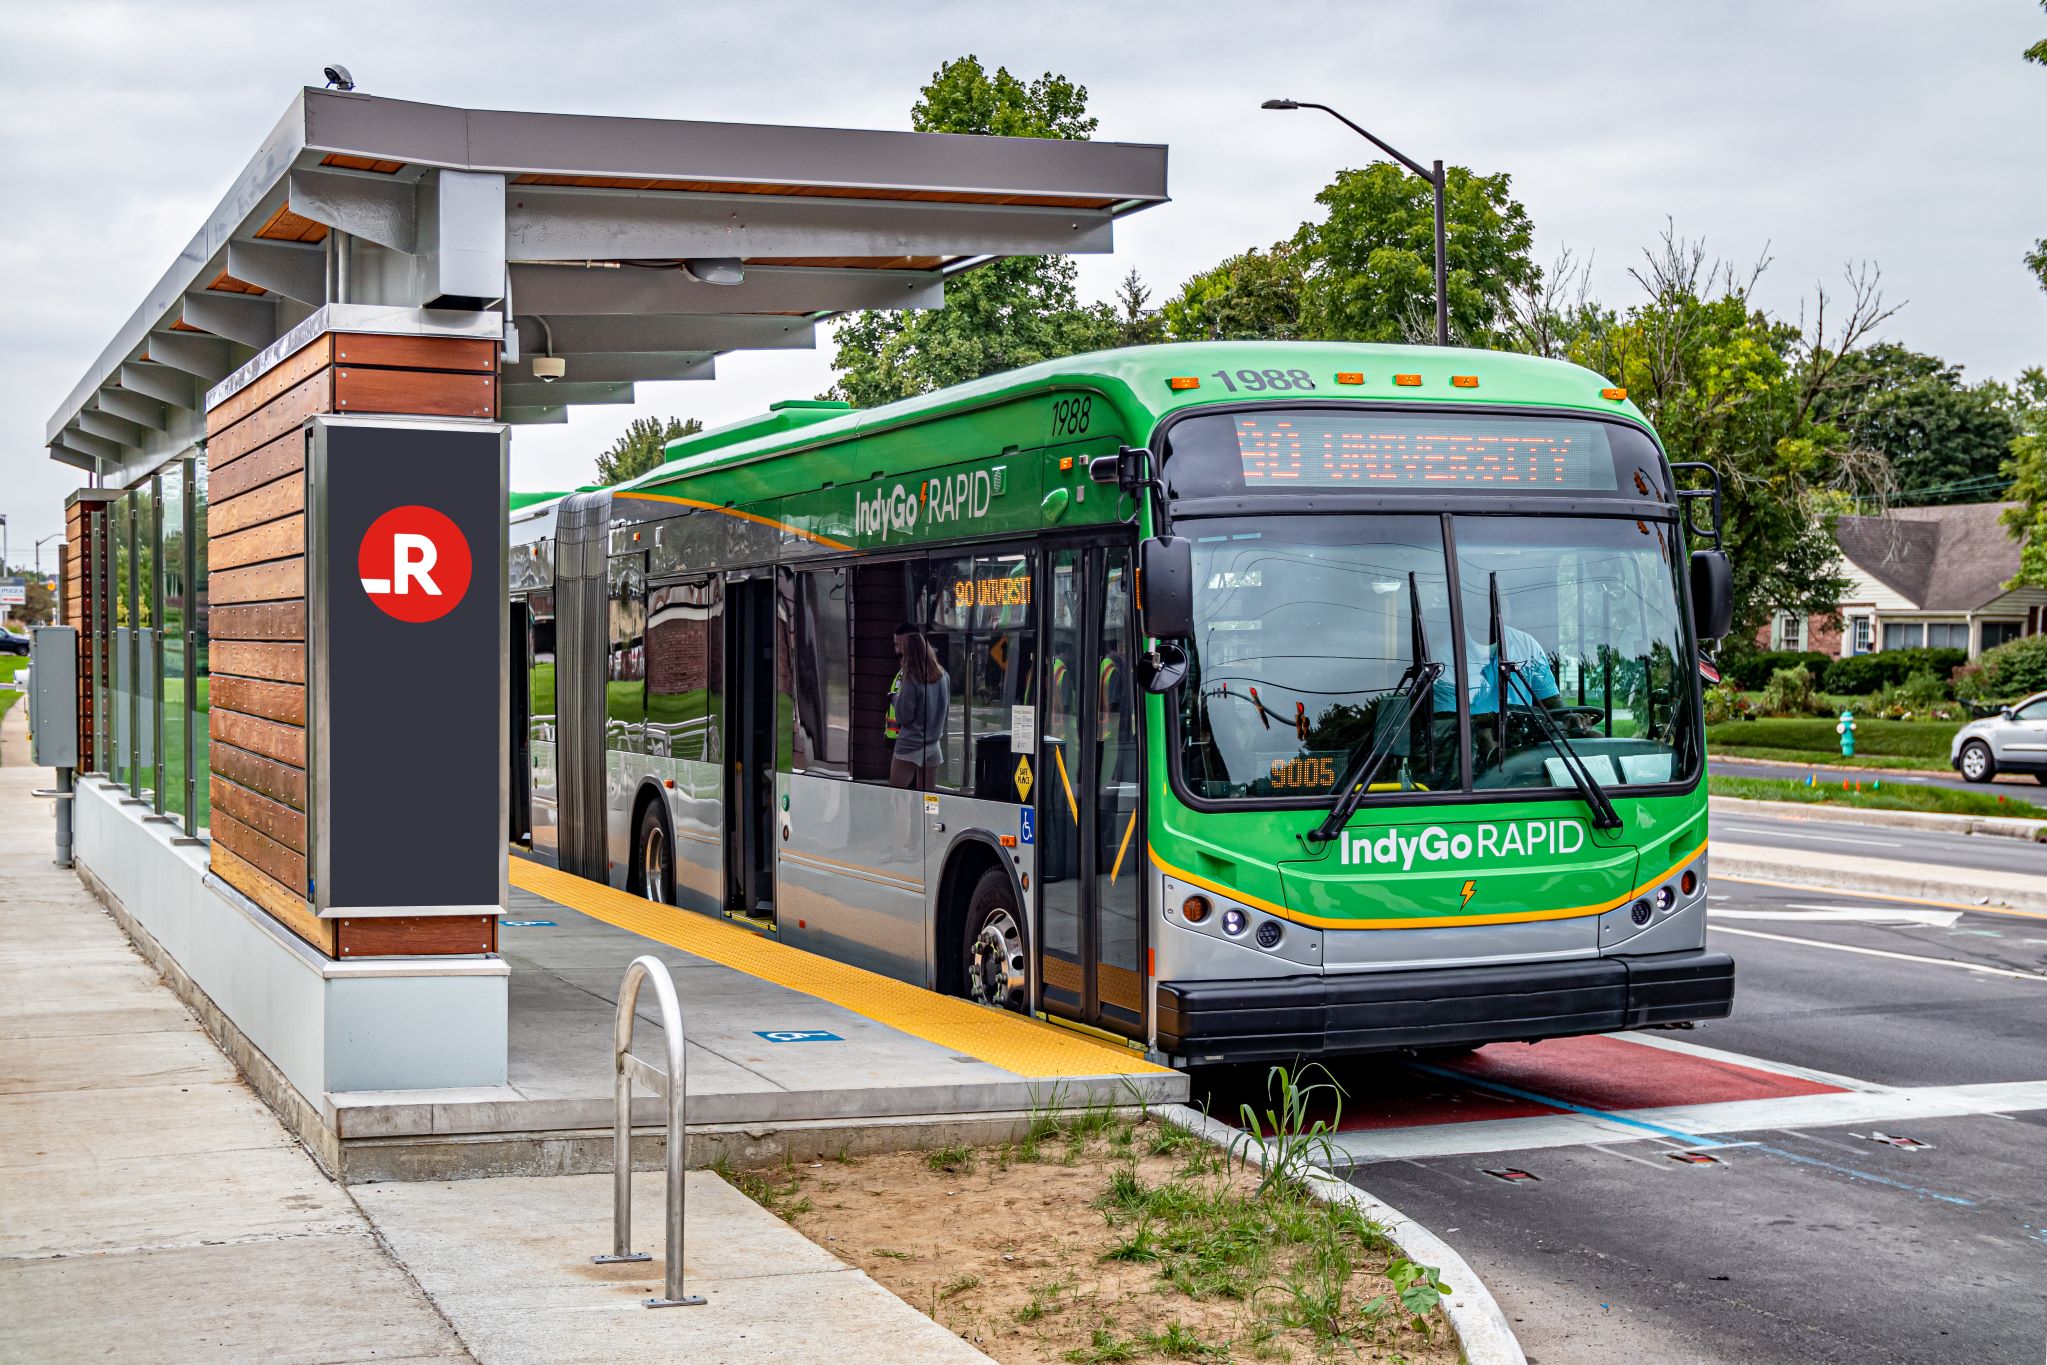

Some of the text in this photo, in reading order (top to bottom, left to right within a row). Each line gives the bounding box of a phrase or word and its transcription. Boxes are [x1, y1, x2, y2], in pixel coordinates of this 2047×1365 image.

[1211, 369, 1316, 392] 1988
[1052, 396, 1091, 437] 1988
[1324, 434, 1572, 481] UNIVERSITY
[855, 470, 990, 541] IndyGo RAPID
[955, 581, 974, 607] 90
[1019, 768, 1028, 776] SAFE
[1271, 757, 1335, 788] 9005
[1340, 820, 1584, 871] IndyGo RAPID
